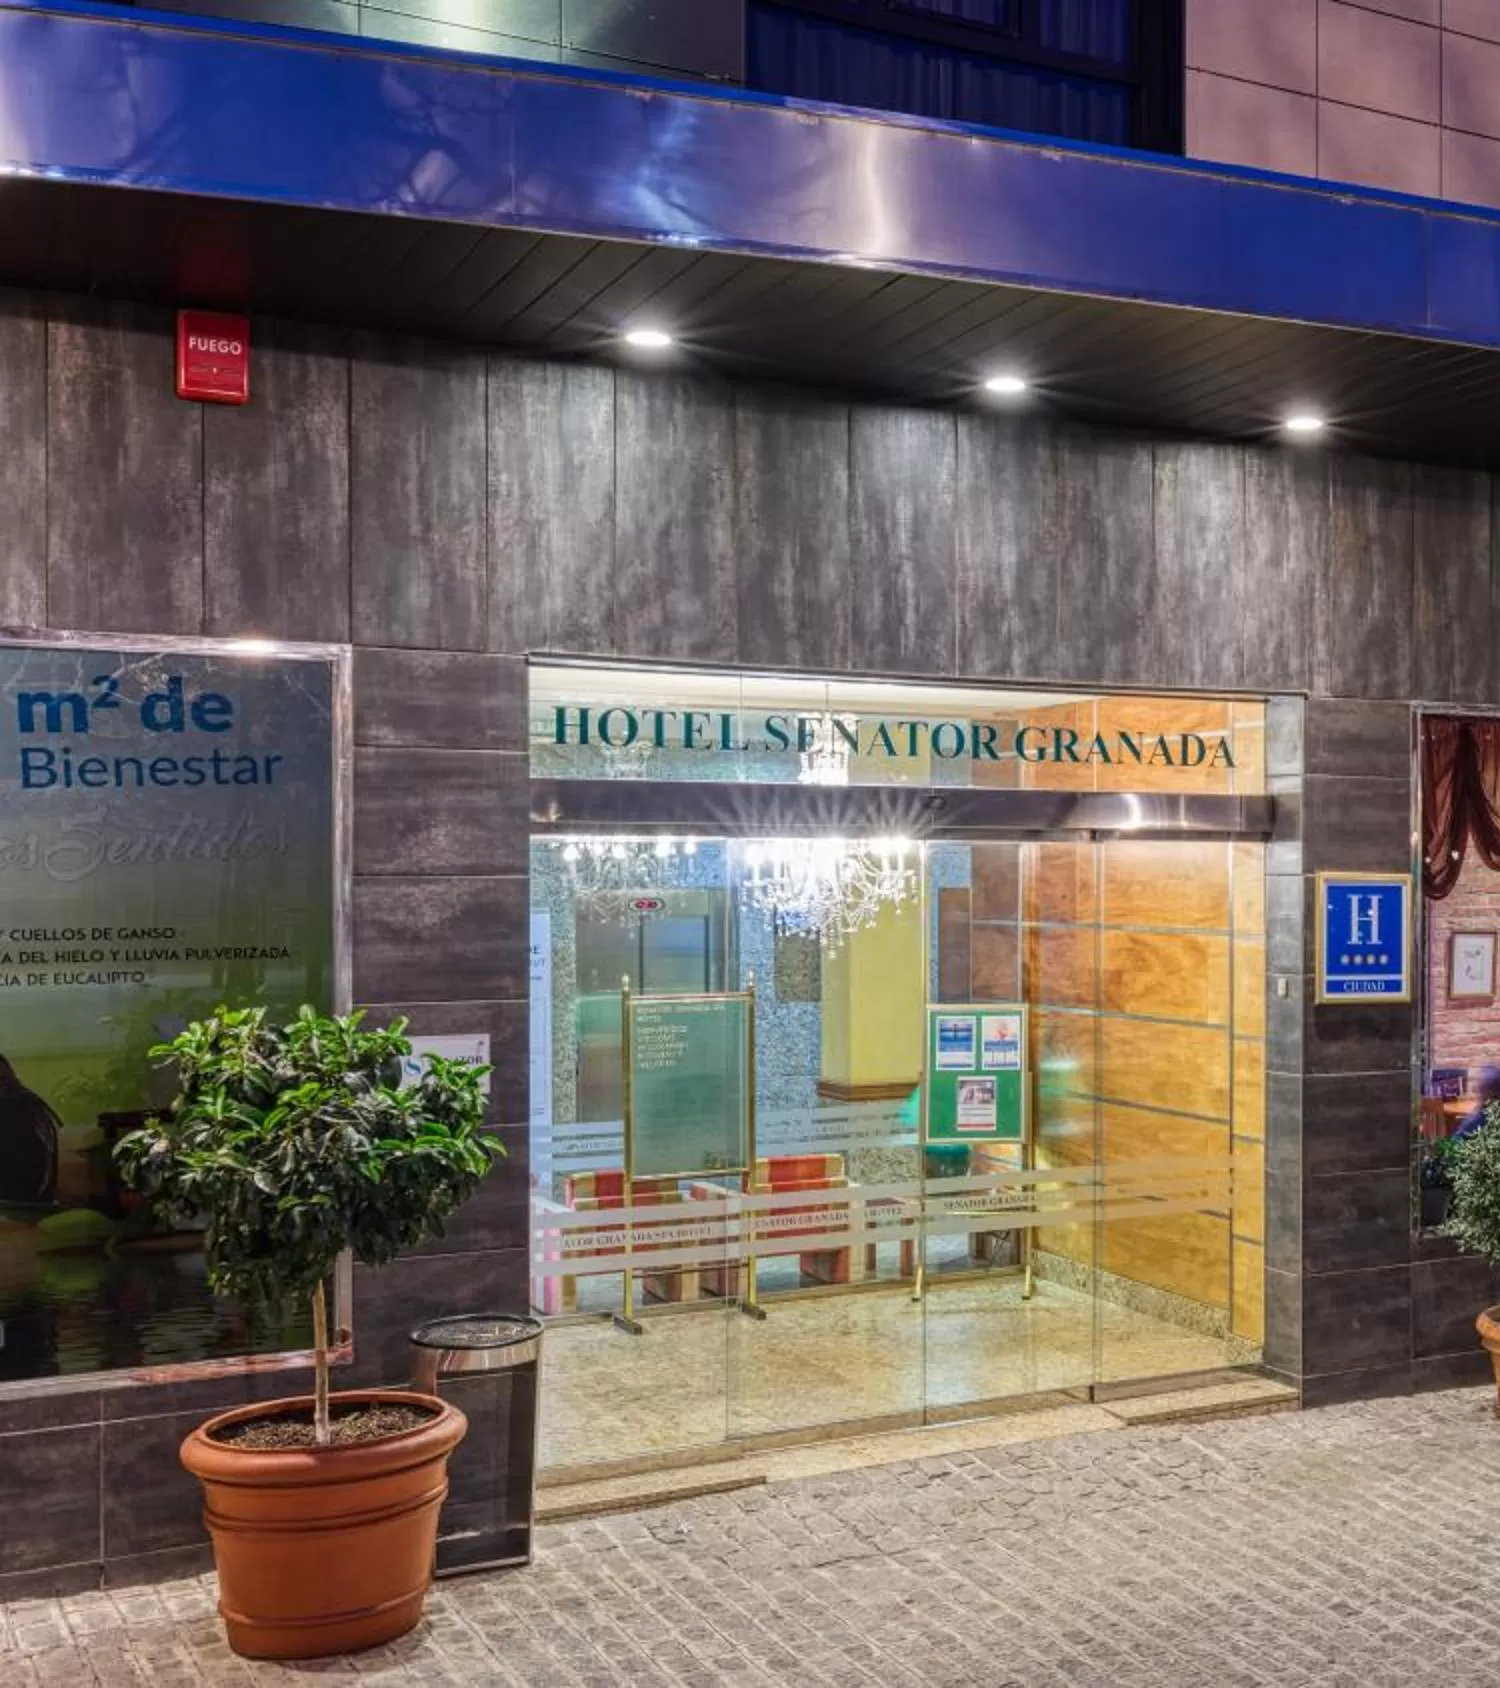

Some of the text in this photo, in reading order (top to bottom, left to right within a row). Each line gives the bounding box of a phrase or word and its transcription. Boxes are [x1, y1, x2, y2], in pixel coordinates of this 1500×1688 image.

[189, 335, 242, 355] FUEGO
[140, 675, 234, 733] de
[554, 706, 1237, 768] HOTEL SENATOR GRANADA
[20, 746, 283, 789] Bienestar
[1346, 893, 1384, 945] H
[9, 928, 86, 941] CUELLOS
[91, 927, 113, 941] DE
[117, 927, 176, 941] GANSO
[19, 951, 48, 965] DEL
[54, 949, 105, 963] HIELO
[110, 947, 121, 961] Y
[125, 946, 179, 961] LLUVIA
[185, 945, 290, 961] PULVERIZADA
[27, 971, 48, 986] DE
[54, 969, 145, 985] EUCALIPTO
[1343, 981, 1386, 993] CIUDAD
